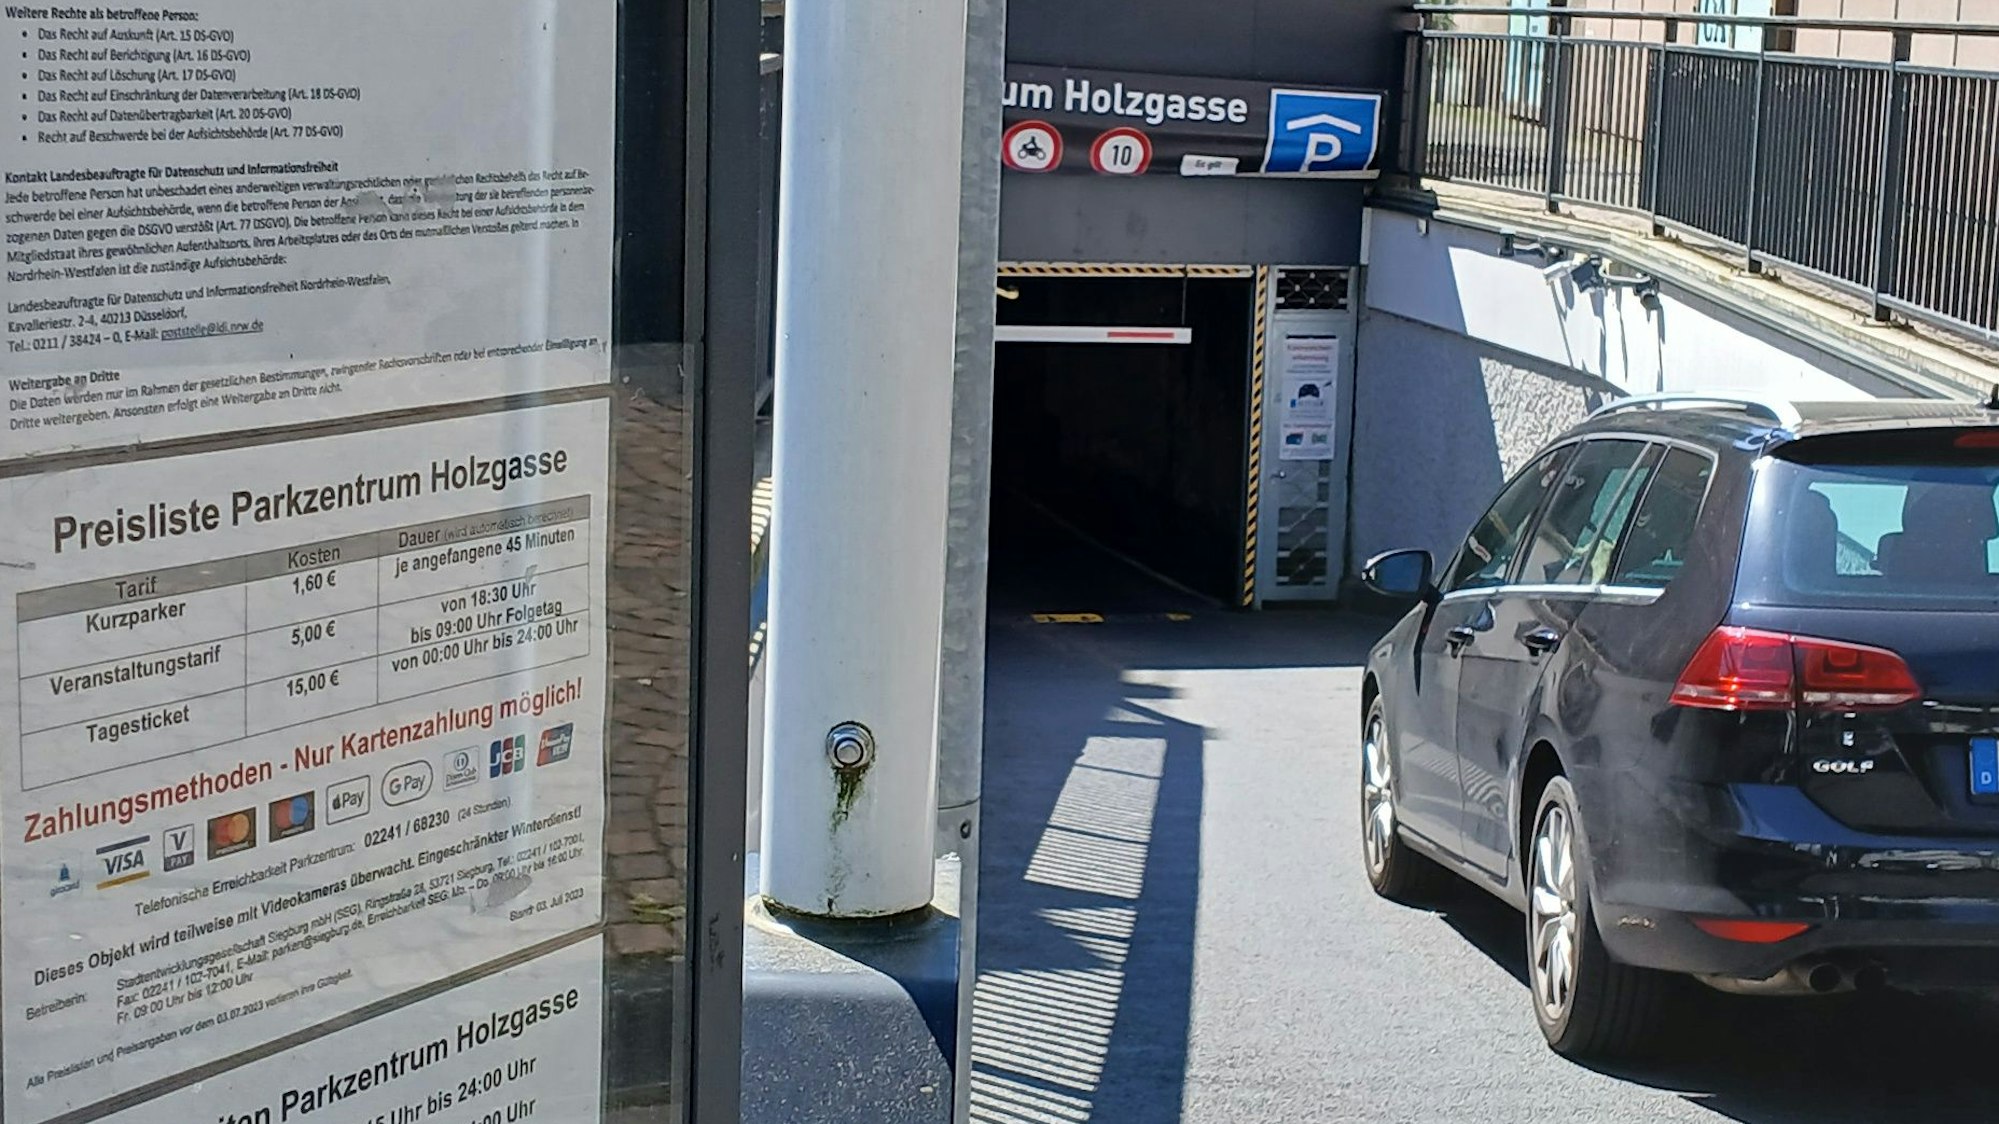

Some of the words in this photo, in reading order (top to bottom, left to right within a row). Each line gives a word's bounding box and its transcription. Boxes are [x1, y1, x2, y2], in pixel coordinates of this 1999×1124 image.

[5, 6, 48, 19] Weitere
[51, 6, 87, 19] Rechte
[89, 7, 104, 19] als
[106, 7, 160, 21] betroffene
[162, 9, 198, 21] Person:
[1064, 79, 1248, 124] Holzgasse
[1113, 144, 1132, 166] 10
[1301, 133, 1343, 173] P
[5, 171, 47, 183] Kontakt
[50, 167, 146, 182] Landesbeauftragte
[148, 166, 162, 178] für
[165, 165, 224, 177] Datenschutz
[226, 163, 245, 175] und
[247, 161, 338, 174] Informationsfreiheit
[8, 375, 71, 391] Weitergabe
[74, 377, 87, 387] an
[89, 371, 120, 383] Dritte
[54, 499, 220, 553] Preisliste
[232, 472, 420, 526] Parkzentrum
[431, 450, 567, 493] Holzgasse
[399, 530, 439, 548] Dauer
[288, 546, 340, 569] Kosten
[394, 557, 408, 578] je
[412, 542, 502, 571] angefangene
[506, 535, 521, 552] 45
[525, 529, 574, 549] Minuten
[115, 576, 158, 599] Tarif
[292, 572, 322, 595] 1,60
[326, 569, 336, 586] €
[441, 597, 466, 613] von
[471, 588, 507, 606] 18:30
[512, 581, 536, 598] Uhr
[86, 602, 186, 633] Kurzparker
[411, 626, 432, 644] bis
[436, 619, 473, 639] 09:00
[477, 610, 503, 630] Uhr
[506, 600, 562, 625] Folgetag
[292, 624, 322, 647] 5,00
[325, 620, 335, 637] €
[392, 658, 418, 673] von
[422, 645, 459, 665] 00:00
[464, 638, 488, 656] Uhr
[492, 630, 514, 649] bis
[516, 622, 552, 645] 24:00
[556, 618, 578, 635] Uhr
[50, 644, 221, 695] Veranstaltungstarif
[286, 672, 326, 696] 15,00
[330, 669, 339, 686] €
[86, 704, 189, 742] Tagesticket
[24, 761, 271, 843] Zahlungsmethoden
[294, 744, 334, 772] Nur
[341, 704, 493, 759] Kartenzahlung
[500, 677, 582, 718] möglich!
[1813, 759, 1874, 774] GOLF
[389, 778, 400, 796] G
[404, 773, 425, 793] Pay
[1981, 771, 1992, 785] D
[342, 791, 364, 809] Pay
[103, 850, 144, 875] VISA
[134, 881, 210, 916] Telefonische
[212, 861, 287, 895] Erreichbarkeit
[289, 842, 355, 872] Parkzentrum:
[364, 823, 401, 847] 02241
[405, 820, 410, 836] /
[413, 809, 450, 833] 68230
[167, 855, 191, 870] PAY
[34, 961, 84, 986] Dieses
[88, 941, 135, 968] Objekt
[139, 931, 169, 953] wird
[173, 916, 233, 942] teilweise
[237, 906, 258, 924] mit
[260, 879, 346, 916] Videokameras
[350, 857, 414, 887] überwacht.
[418, 830, 509, 866] Eingeschränkter
[511, 804, 581, 837] Winterdienst!
[26, 993, 86, 1020] Betreiberin:
[282, 1038, 447, 1122] Parkzentrum
[457, 988, 578, 1053] Holzgasse
[391, 1104, 422, 1124] Uhr
[427, 1091, 452, 1115] bis
[458, 1068, 501, 1103] 24:00
[507, 1058, 537, 1081] Uhr
[507, 1100, 536, 1123] Uhr
